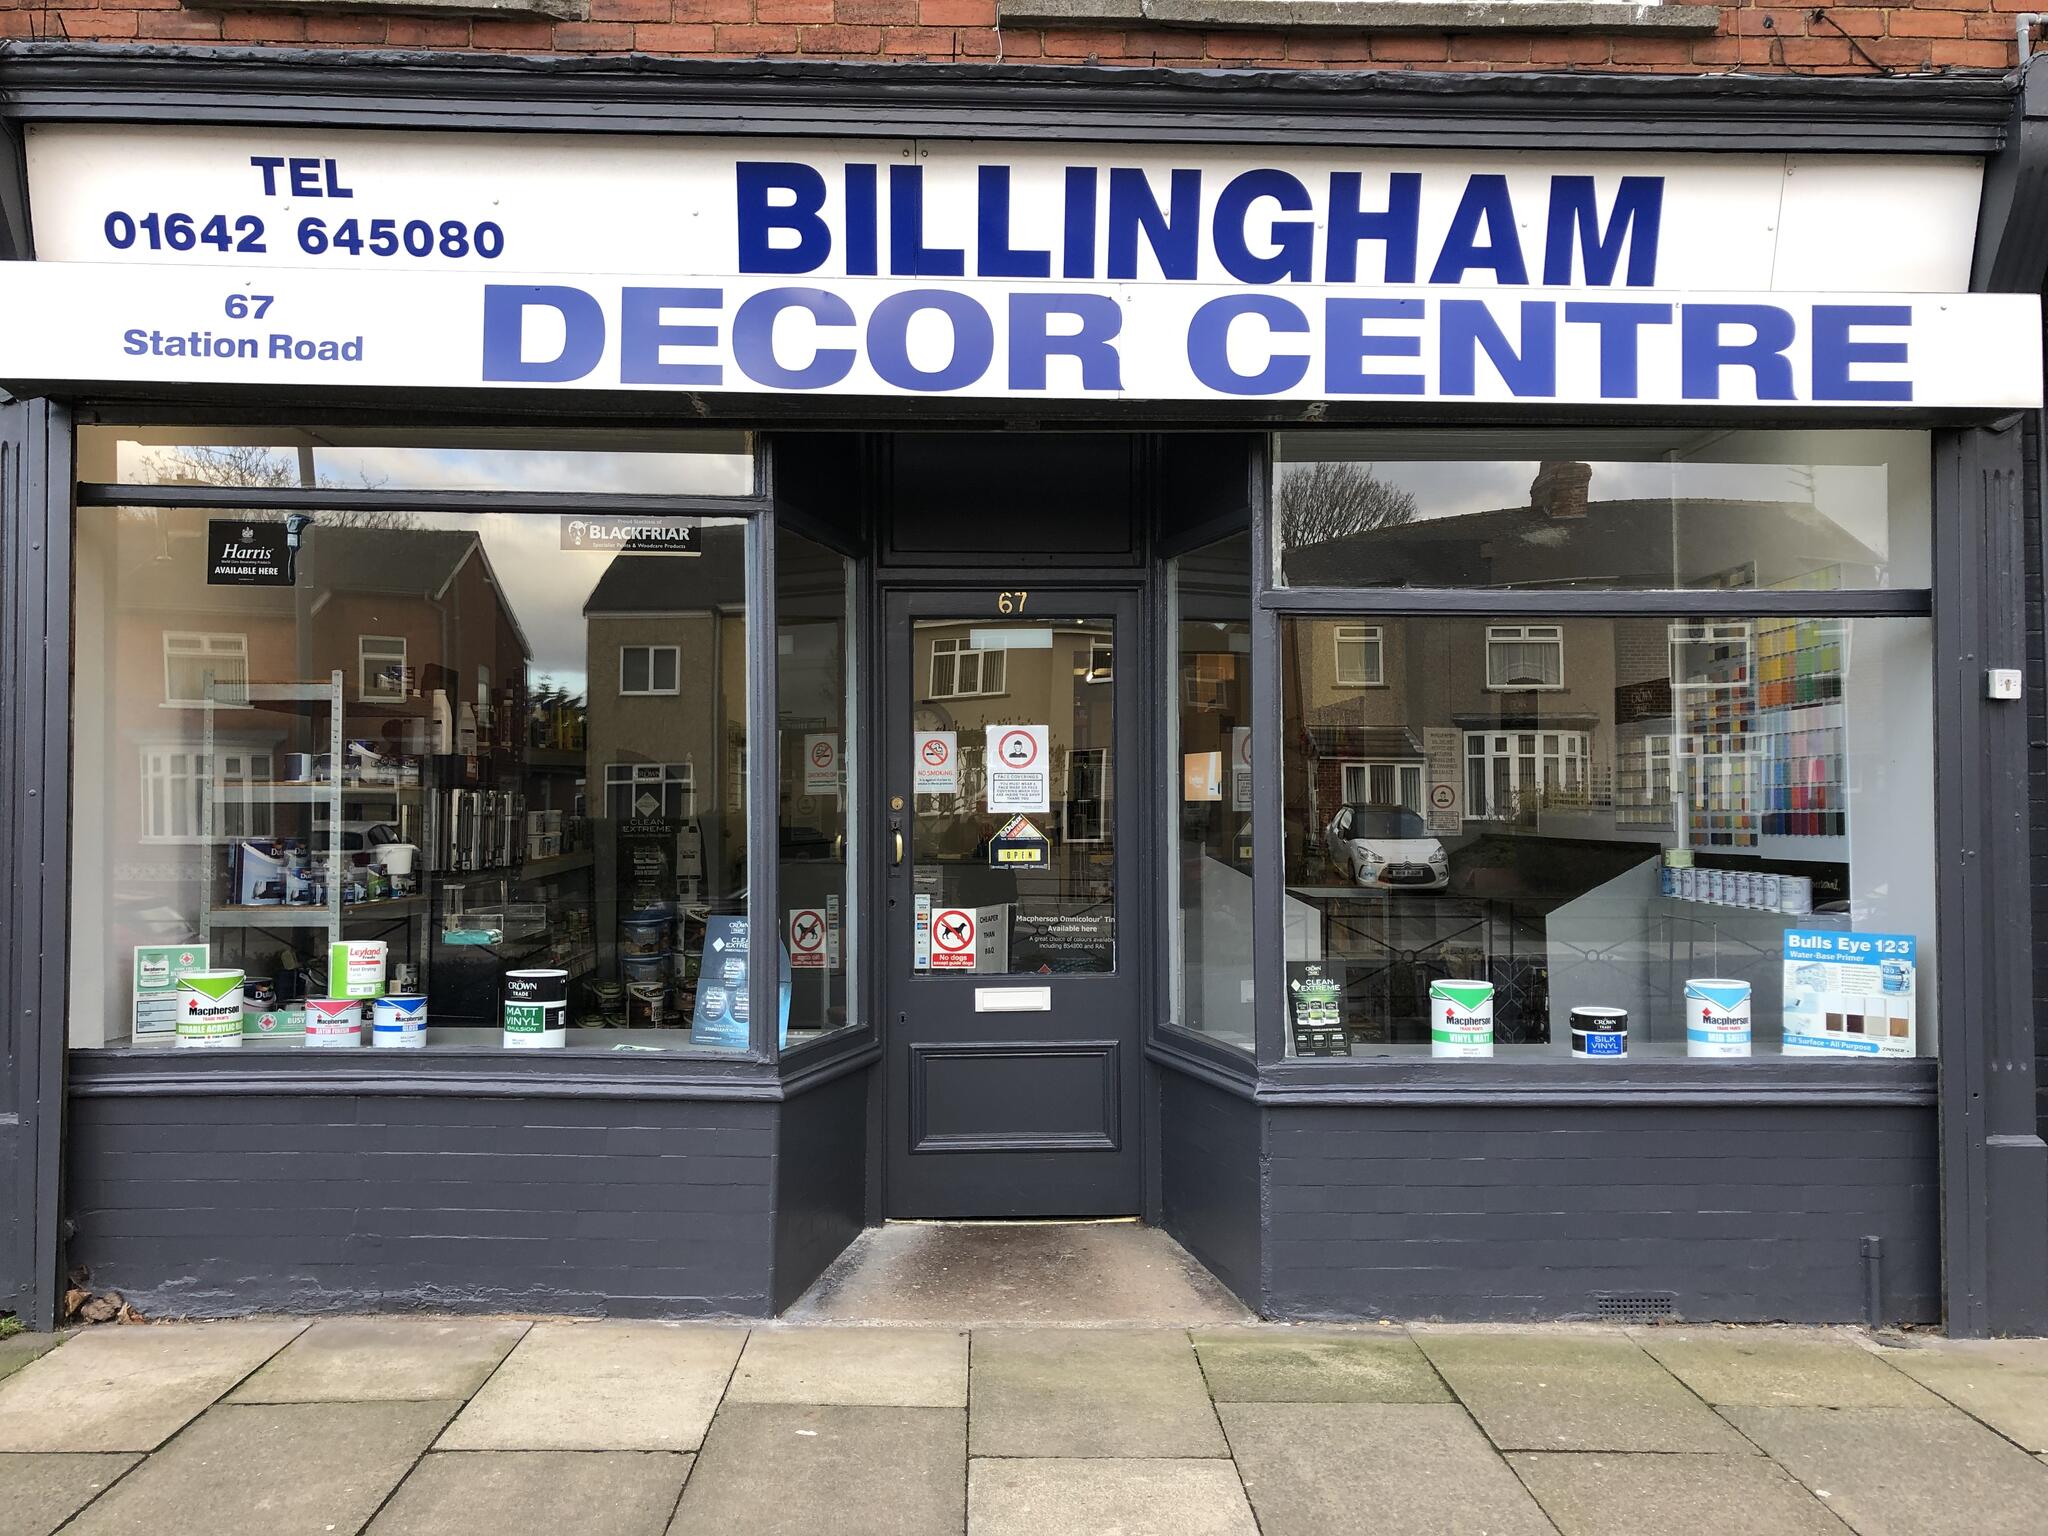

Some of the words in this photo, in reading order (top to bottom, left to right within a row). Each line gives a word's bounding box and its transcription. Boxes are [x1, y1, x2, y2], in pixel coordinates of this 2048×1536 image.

[250, 156, 353, 198] TEL
[736, 162, 1665, 287] BILLINGHAM
[104, 211, 267, 253] 01642
[297, 218, 504, 259] 645080
[224, 294, 274, 320] 67
[123, 330, 259, 358] Station
[268, 333, 363, 361] Road
[482, 284, 1124, 392] DECOR
[1187, 294, 1913, 401] CENTRE
[589, 525, 690, 541] BLACKFRIAR
[222, 543, 272, 560] Harris
[215, 566, 257, 575] AVAILABLE
[258, 567, 279, 576] HERE
[998, 591, 1028, 614] 67
[630, 818, 665, 826] CLEAN
[622, 825, 672, 833] EXTREME
[1006, 851, 1033, 860] OPEN
[979, 914, 999, 923] CHEAPER
[1016, 915, 1059, 923] Macpherson
[1060, 915, 1101, 923] Omnicolour
[1788, 934, 1833, 950] Bulls
[1838, 937, 1871, 953] Eye
[349, 947, 381, 957] Leyland
[984, 947, 995, 955] B&Q
[1789, 950, 1836, 961] Water-Base
[1836, 952, 1865, 962] Primer
[950, 954, 968, 962] dogs
[507, 980, 538, 991] CROWN
[188, 1005, 240, 1016] Macpherson
[506, 1006, 539, 1016] MATT
[287, 1016, 305, 1024] BUSY
[506, 1017, 540, 1026] VINYL
[1448, 1033, 1473, 1043] VINYL
[1473, 1033, 1490, 1043] MATT
[1594, 1035, 1616, 1043] SILK
[1591, 1042, 1620, 1050] VINYL
[1801, 1037, 1825, 1046] Surface
[1829, 1040, 1841, 1048] All
[1841, 1042, 1872, 1052] Purpose
